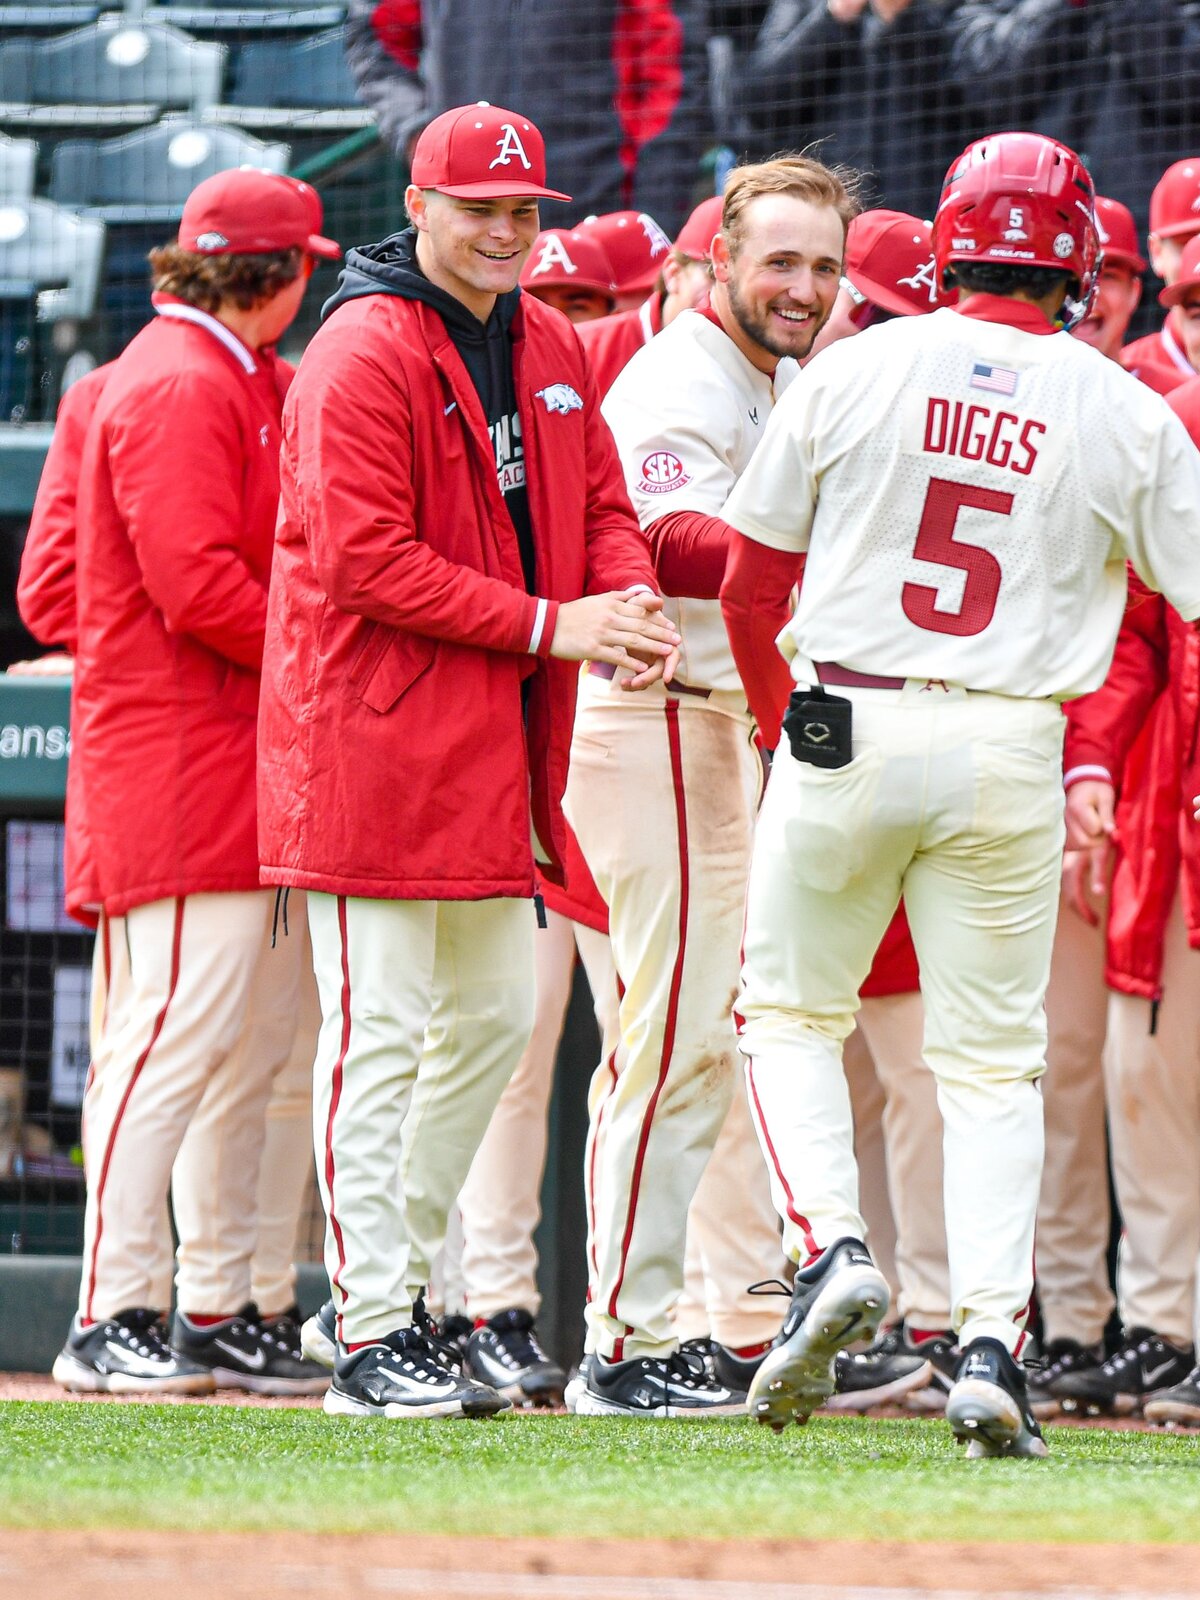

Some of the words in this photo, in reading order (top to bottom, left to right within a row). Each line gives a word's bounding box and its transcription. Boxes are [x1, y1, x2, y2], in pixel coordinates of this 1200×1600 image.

[489, 123, 532, 169] A
[1009, 208, 1024, 228] 5
[530, 234, 578, 278] A
[896, 254, 937, 303] A
[923, 397, 1046, 475] DIGGS
[642, 452, 682, 484] SEC
[901, 477, 1015, 637] 5
[0, 724, 71, 760] ans
